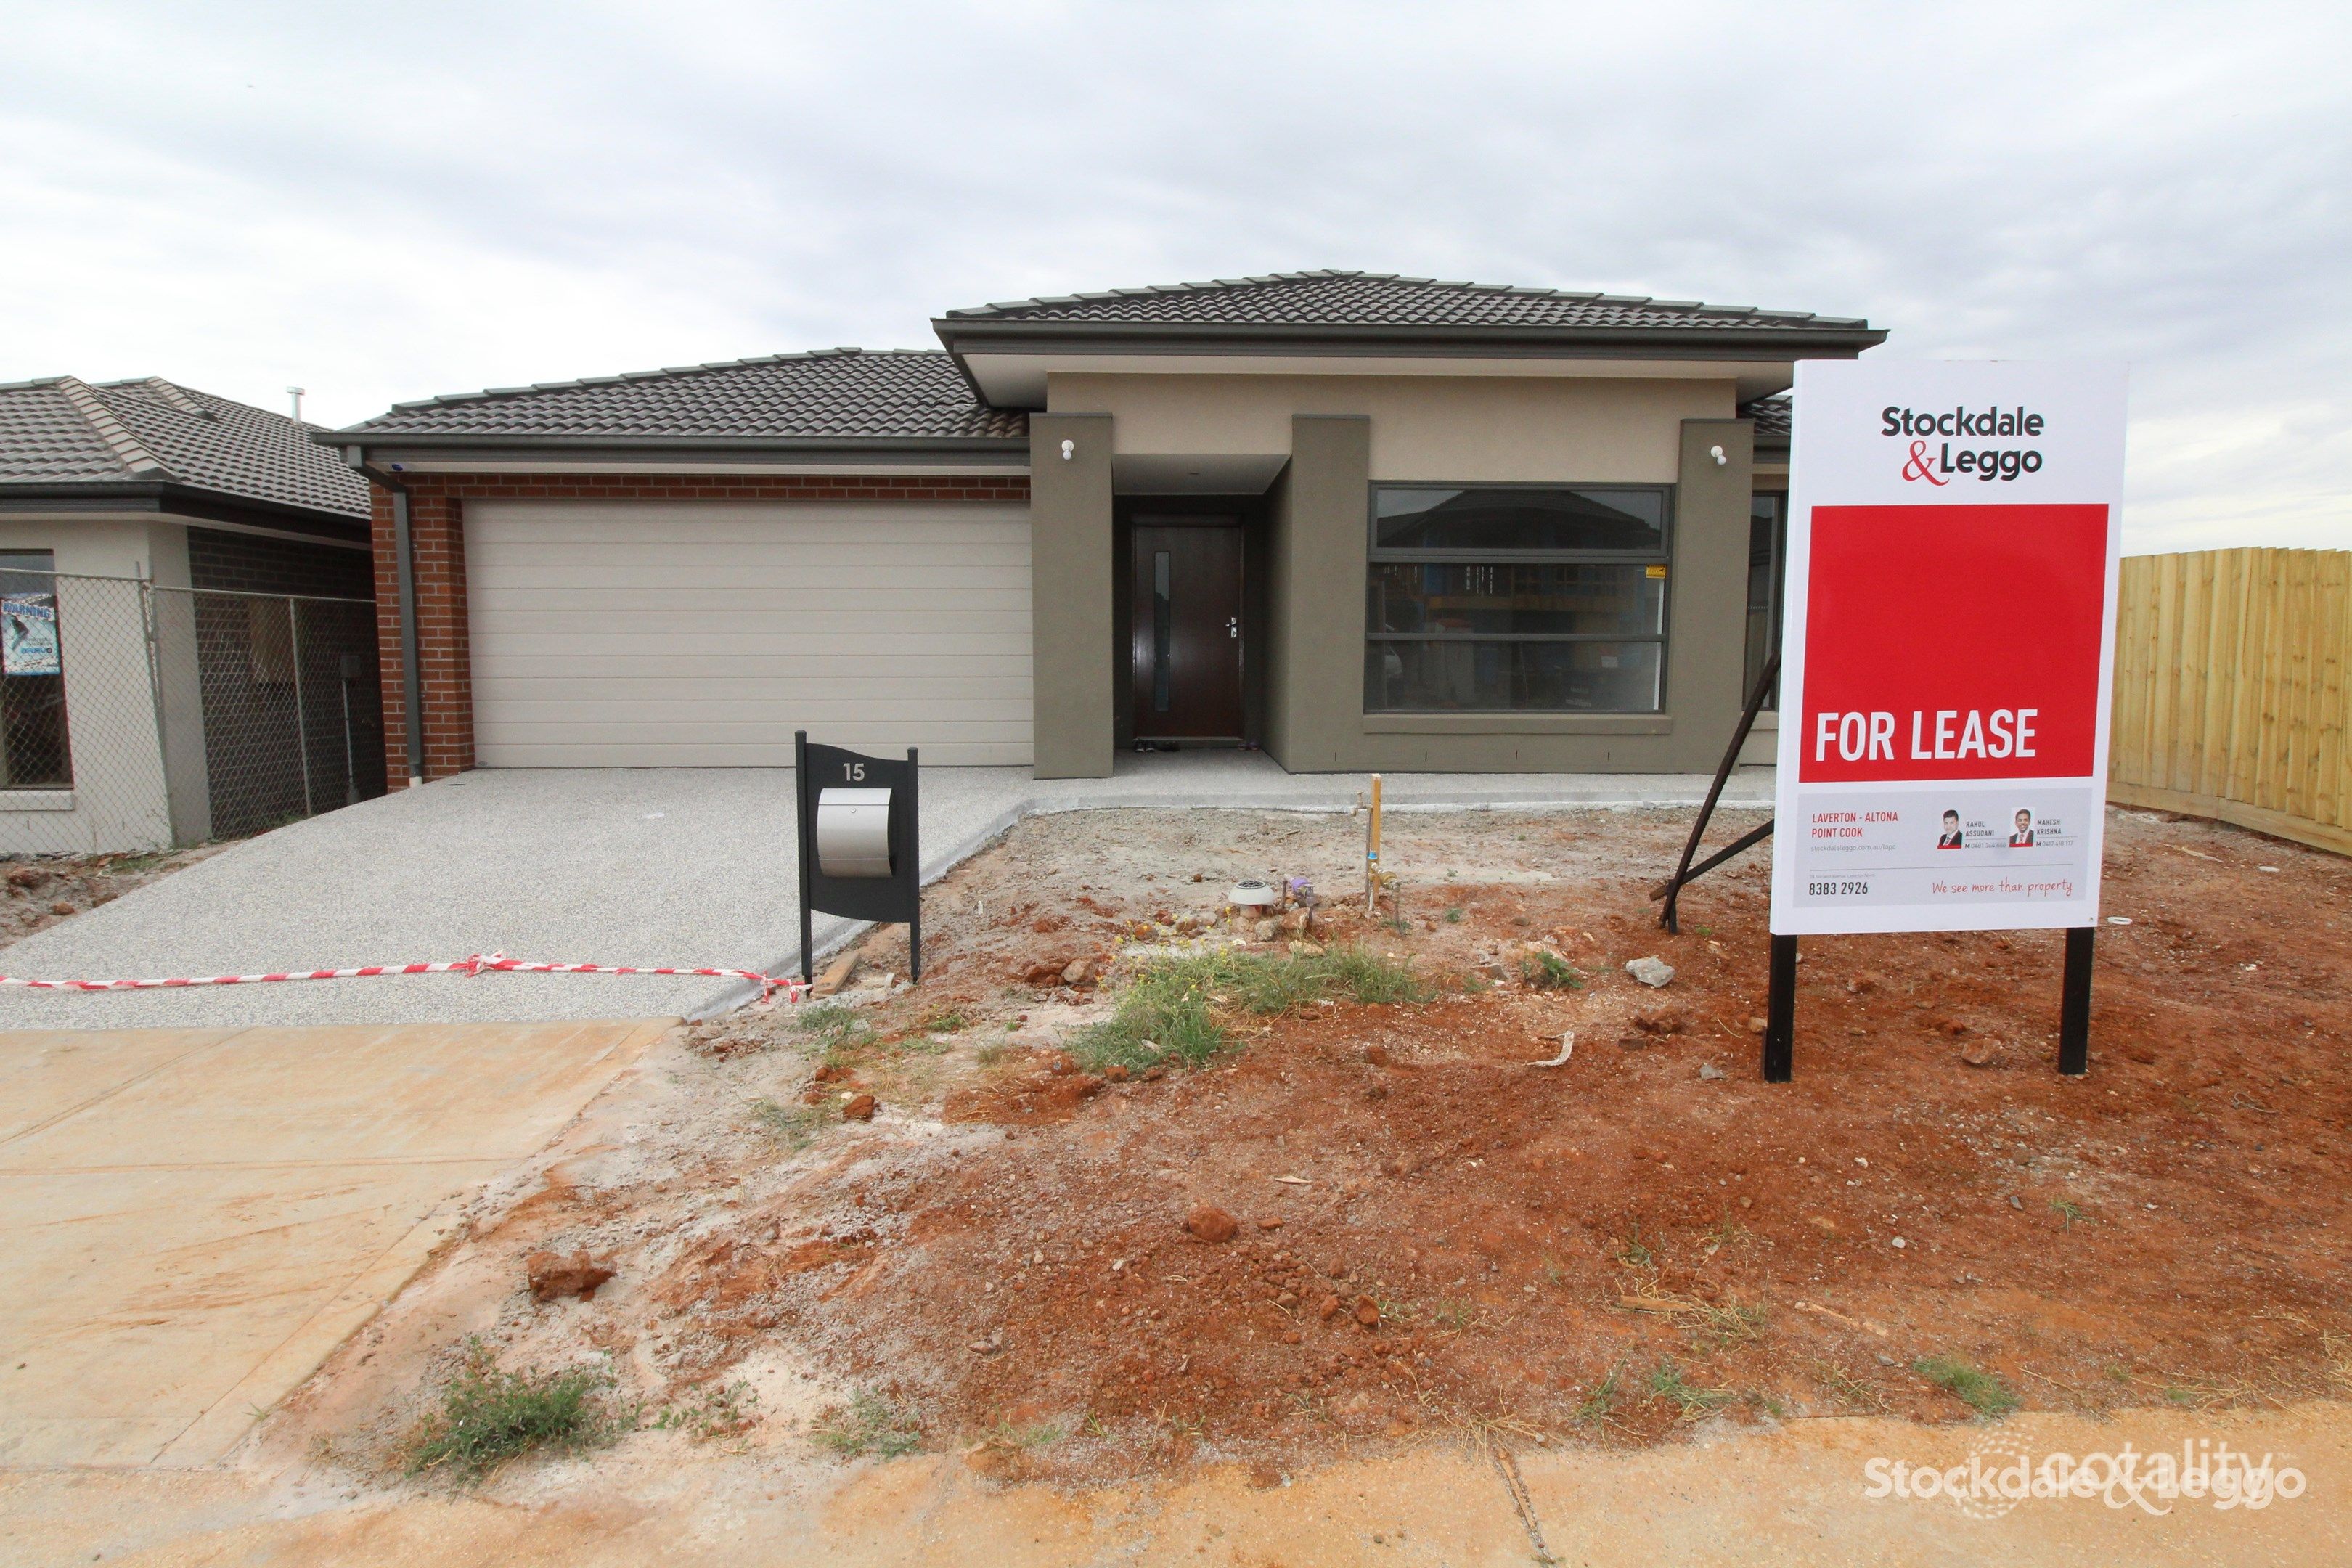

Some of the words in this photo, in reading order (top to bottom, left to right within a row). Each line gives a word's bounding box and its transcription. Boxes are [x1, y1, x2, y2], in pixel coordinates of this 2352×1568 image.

[1881, 406, 2044, 436] Stockdale
[1902, 440, 1950, 486] &
[1940, 442, 2043, 481] Leggo
[3, 601, 52, 618] WARNING
[1816, 711, 1895, 761] FOR
[1911, 709, 2038, 759] LEASE
[843, 763, 865, 782] 15
[1812, 812, 1856, 823] LAVERTON
[1864, 812, 1898, 822] ALTONA
[1811, 828, 1837, 838] POINT
[1839, 828, 1863, 838] COOK
[1809, 882, 1837, 895] 8383
[1841, 881, 1868, 894] 2926
[1932, 880, 1947, 894] We
[1999, 877, 2024, 891] than
[2028, 879, 2073, 897] property
